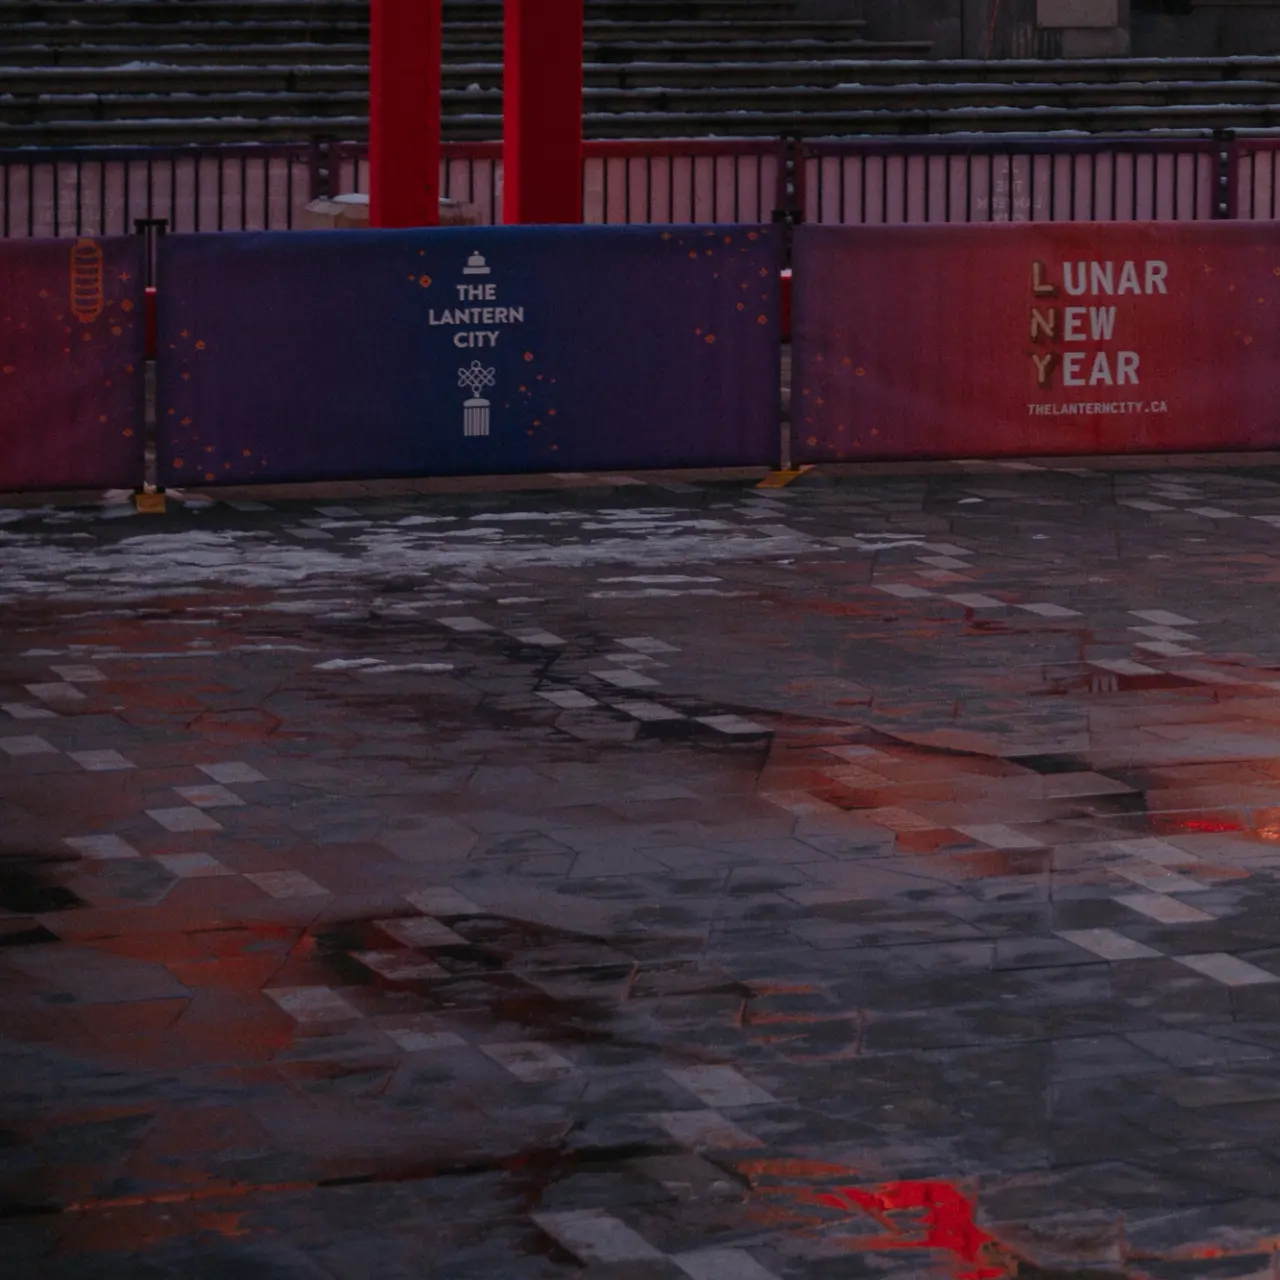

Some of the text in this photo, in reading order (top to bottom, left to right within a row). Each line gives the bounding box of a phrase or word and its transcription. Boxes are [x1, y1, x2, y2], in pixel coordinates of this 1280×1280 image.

[1033, 258, 1169, 298] LUNAR
[456, 283, 497, 302] THE
[428, 306, 525, 326] LANTERN
[1030, 304, 1118, 341] NEW
[452, 330, 501, 349] CITY
[1030, 350, 1141, 387] YEAR
[1028, 400, 1168, 415] THELANTERNCITY.CA
